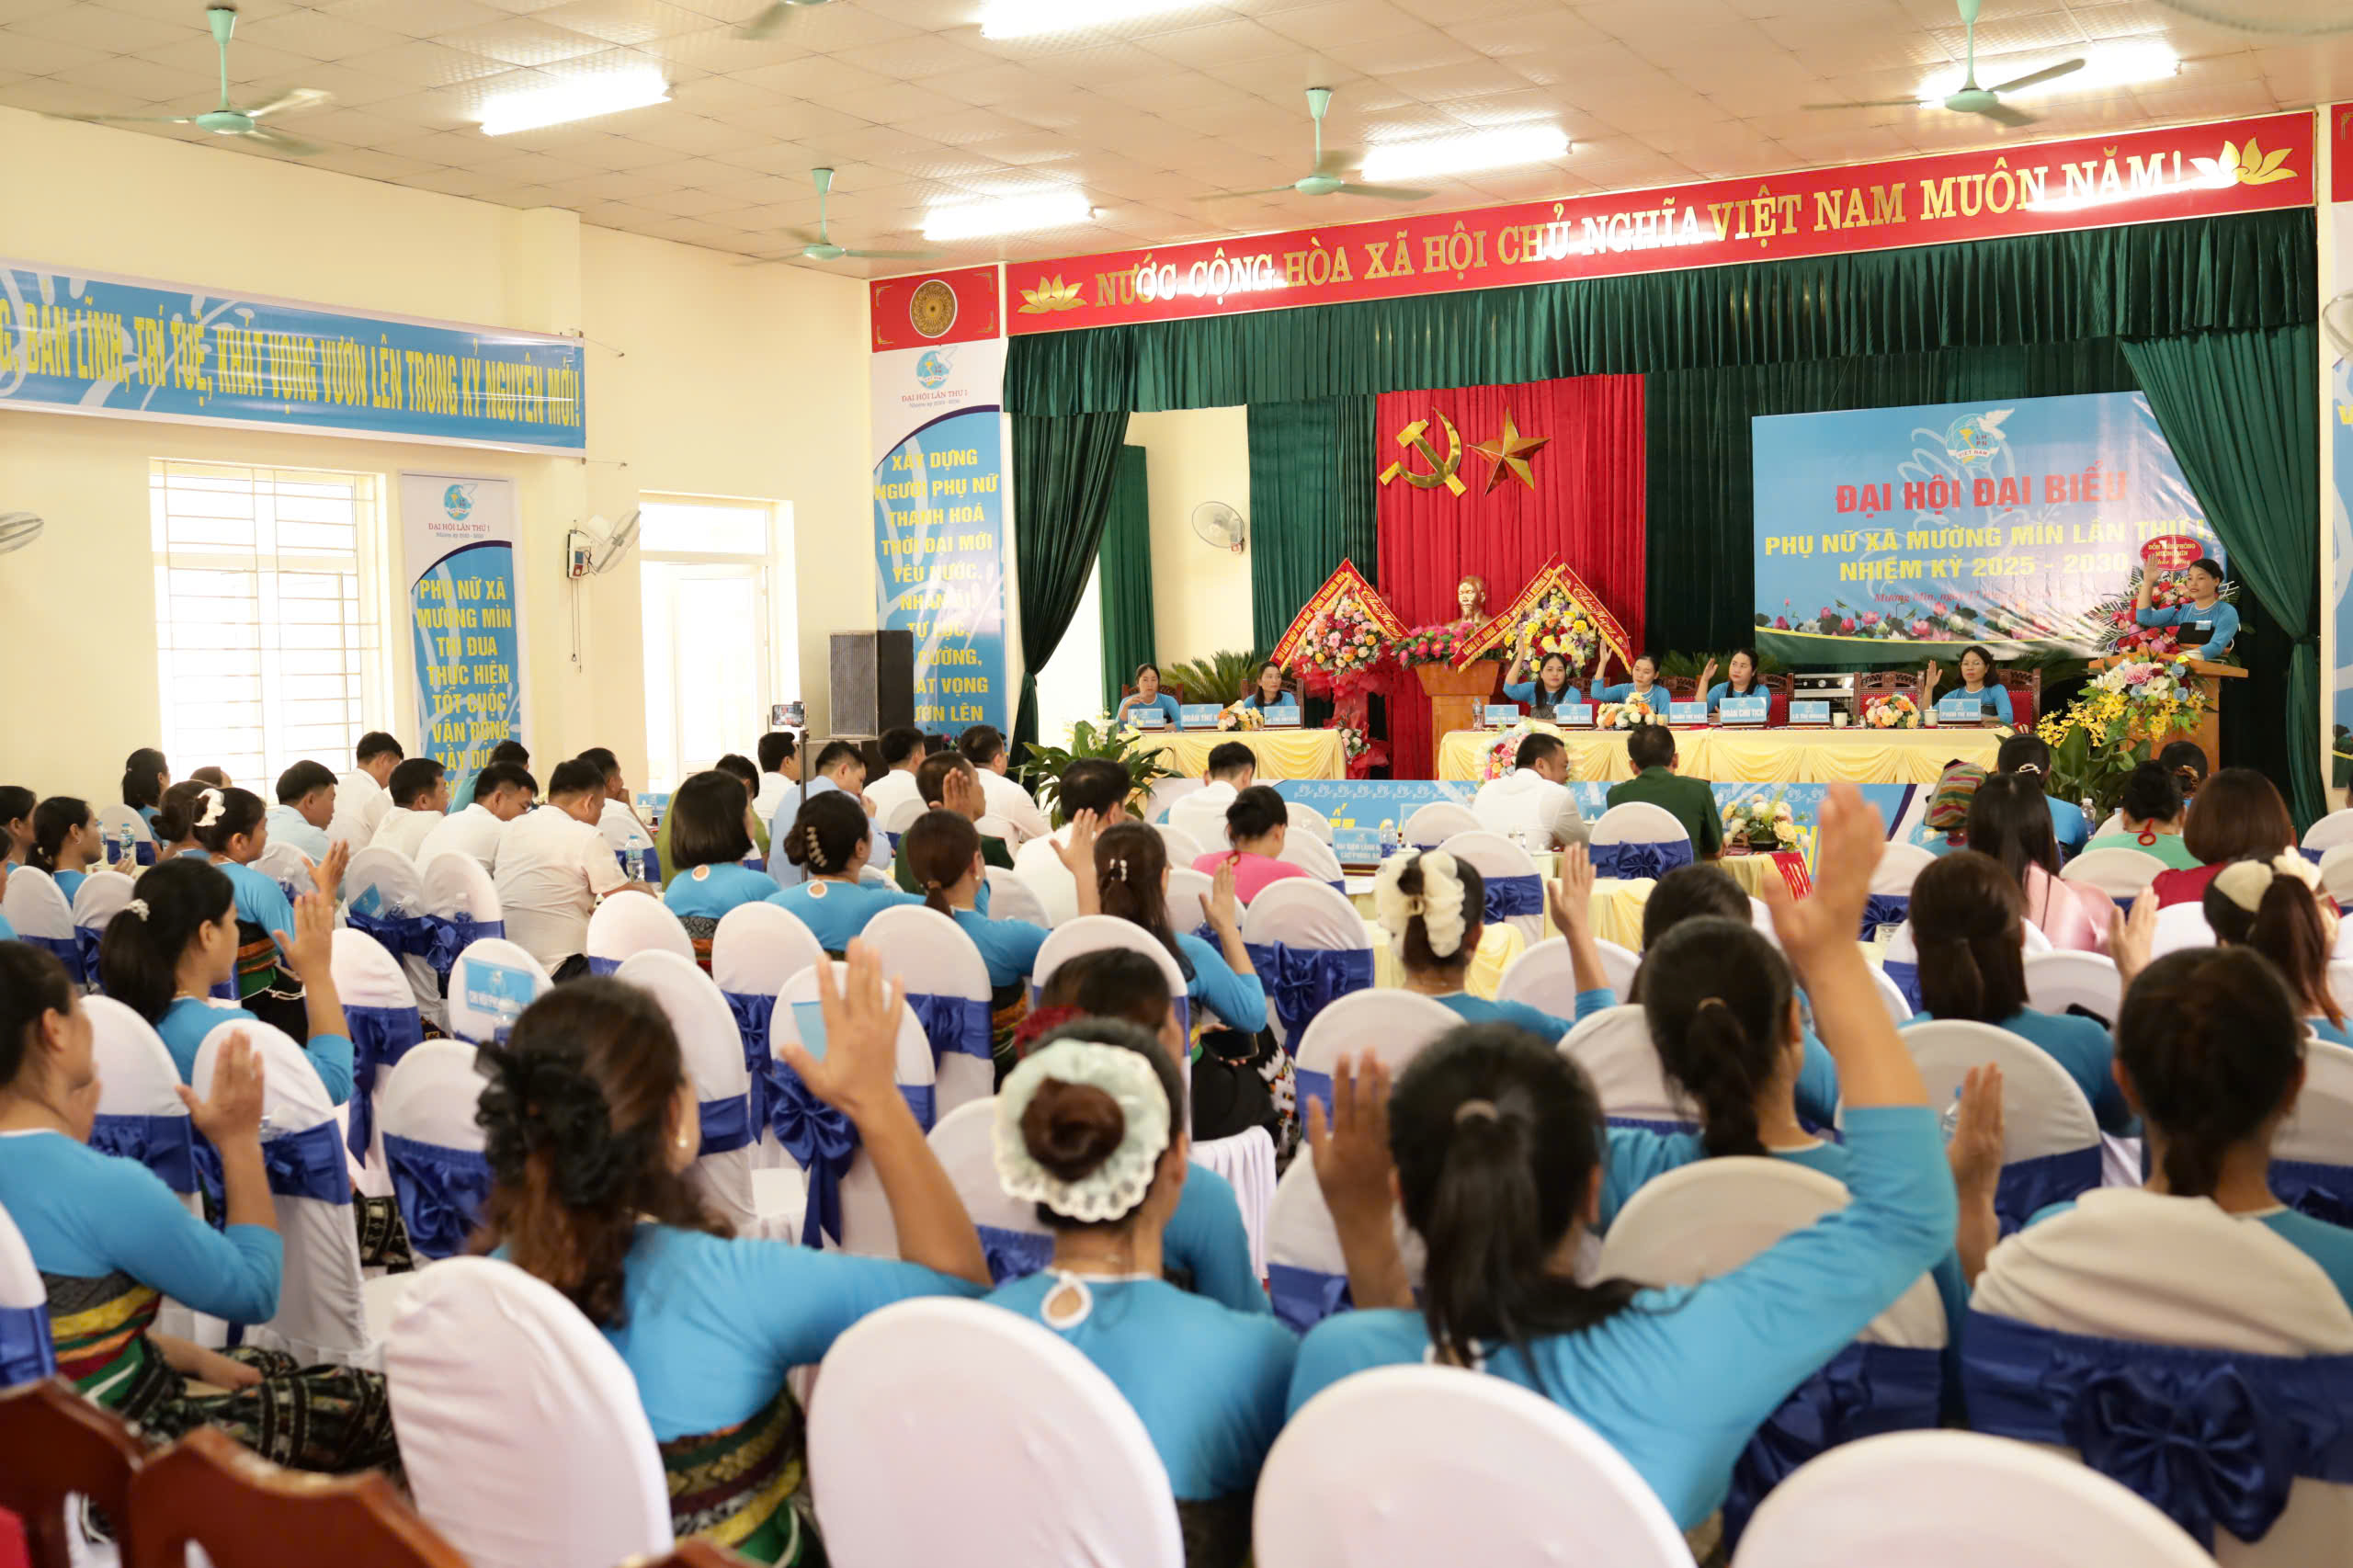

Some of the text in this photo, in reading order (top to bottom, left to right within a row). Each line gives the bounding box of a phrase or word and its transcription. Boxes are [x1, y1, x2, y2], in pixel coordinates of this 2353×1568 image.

[1096, 253, 1177, 307] NƯỚC
[1188, 247, 1275, 304] CỘNG
[1284, 236, 1353, 287] HÒA
[1363, 230, 1415, 279] XÃ
[1423, 221, 1488, 279] HỘI
[1496, 202, 1570, 265] CHỦ
[1581, 203, 1700, 255] NGHĨA
[1708, 185, 1802, 249] VIỆT
[1813, 184, 1907, 232] NAM
[1920, 157, 2045, 221] MUÔN
[76, 295, 130, 392] LĨNH,
[134, 304, 165, 386] TRÍ
[171, 311, 212, 405] TUỆ,
[218, 317, 263, 395] KHÁT
[269, 334, 317, 414] VỌNG
[321, 335, 368, 405] VƯƠN
[371, 335, 402, 410] LÊN
[406, 350, 458, 415] TRONG
[462, 339, 481, 417] KỶ
[486, 353, 543, 423] NGUYÊN
[549, 358, 579, 426] MỚI!
[892, 449, 978, 471] XÂY DỰNG
[874, 473, 999, 500] NGƯỜI PHỤ NỮ
[1836, 459, 2128, 517] ĐẠI HỘI ĐẠI BIỂU
[889, 509, 944, 528] THANH
[881, 533, 993, 556] THỜI ĐẠI MỚI
[1766, 536, 1813, 558] PHỤ
[1822, 529, 1857, 553] NỮ
[1865, 528, 1898, 551] XÃ
[1907, 521, 2002, 550] MƯỜNG
[2012, 520, 2063, 545] MÌN
[2073, 515, 2126, 541] LẦN
[892, 563, 925, 583] YÊU
[1839, 558, 1923, 583] NHIỆM
[1931, 553, 1965, 579] KỲ
[1972, 556, 2036, 575] 2025
[2063, 553, 2131, 574] 2030
[419, 576, 506, 605] PHỤ NỮ XÃ
[416, 604, 512, 628] MƯỜNG MÌN
[436, 636, 497, 657] THI ĐUA
[918, 648, 983, 666] CƯỜNG,
[426, 662, 509, 690] THỰC HIỆN
[941, 677, 989, 696] VỌNG
[432, 686, 507, 717] TỐT CUỘC
[951, 702, 983, 722] LÊN
[471, 719, 509, 745] ĐỘNG
